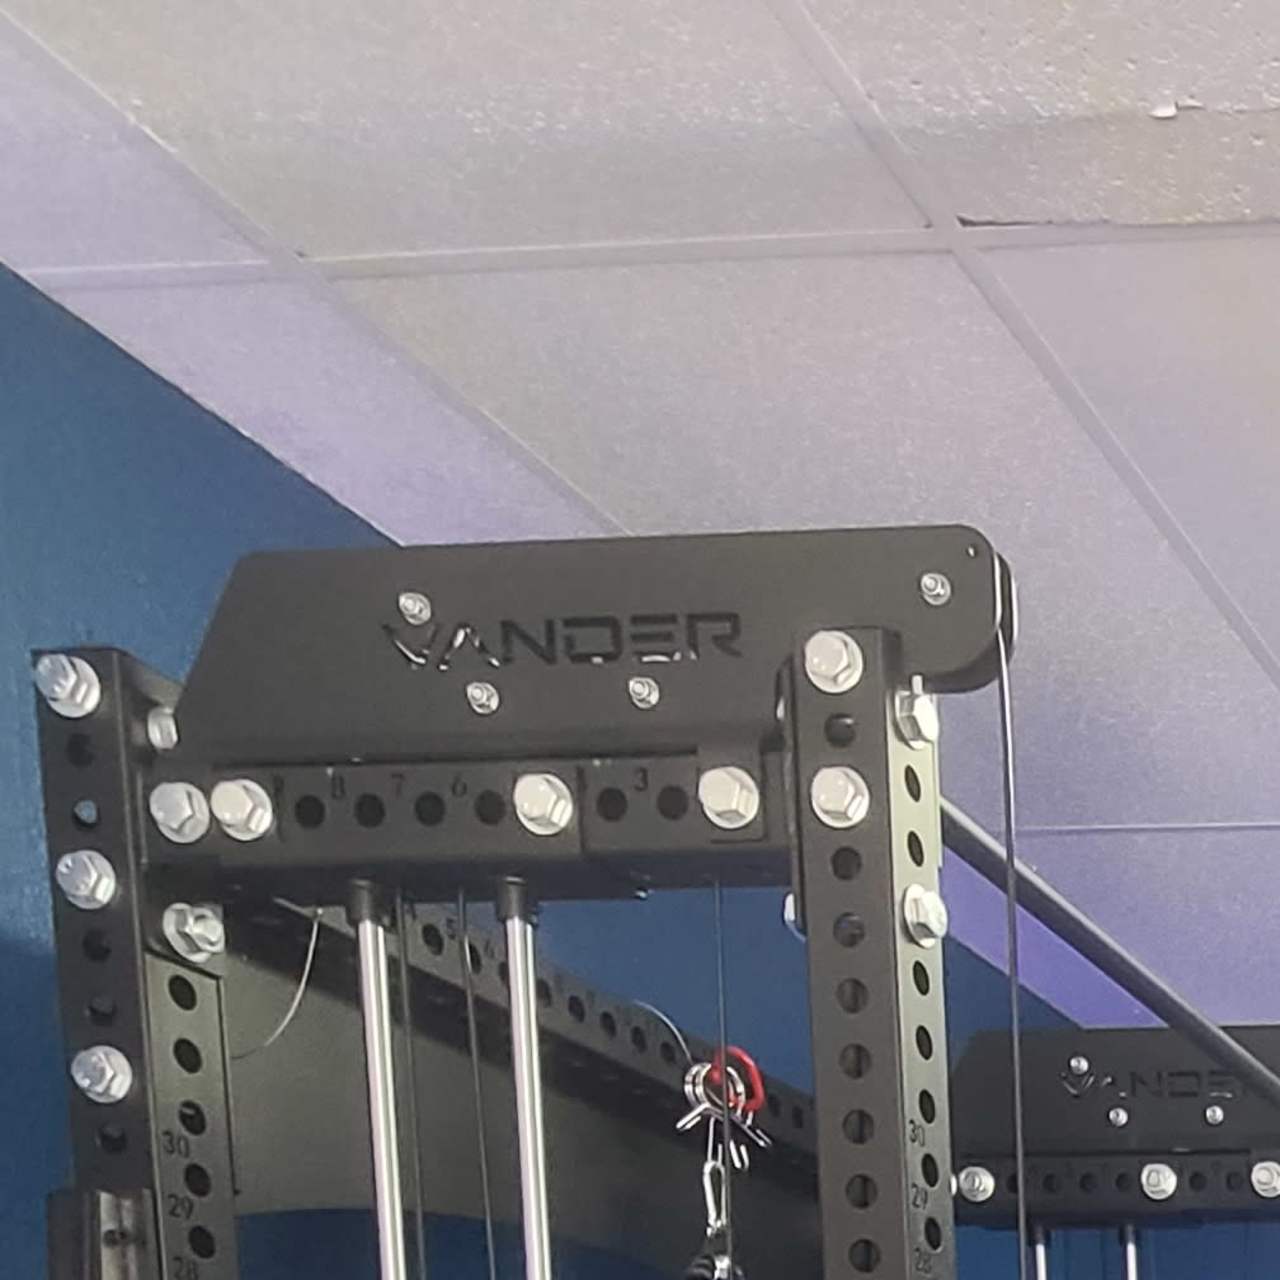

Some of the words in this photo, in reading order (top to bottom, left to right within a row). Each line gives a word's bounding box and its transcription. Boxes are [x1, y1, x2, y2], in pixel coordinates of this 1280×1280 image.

[382, 612, 742, 671] VANDER
[450, 775, 468, 798] 6
[633, 766, 649, 792] 3
[161, 1130, 191, 1158] 30
[167, 1193, 194, 1220] 29
